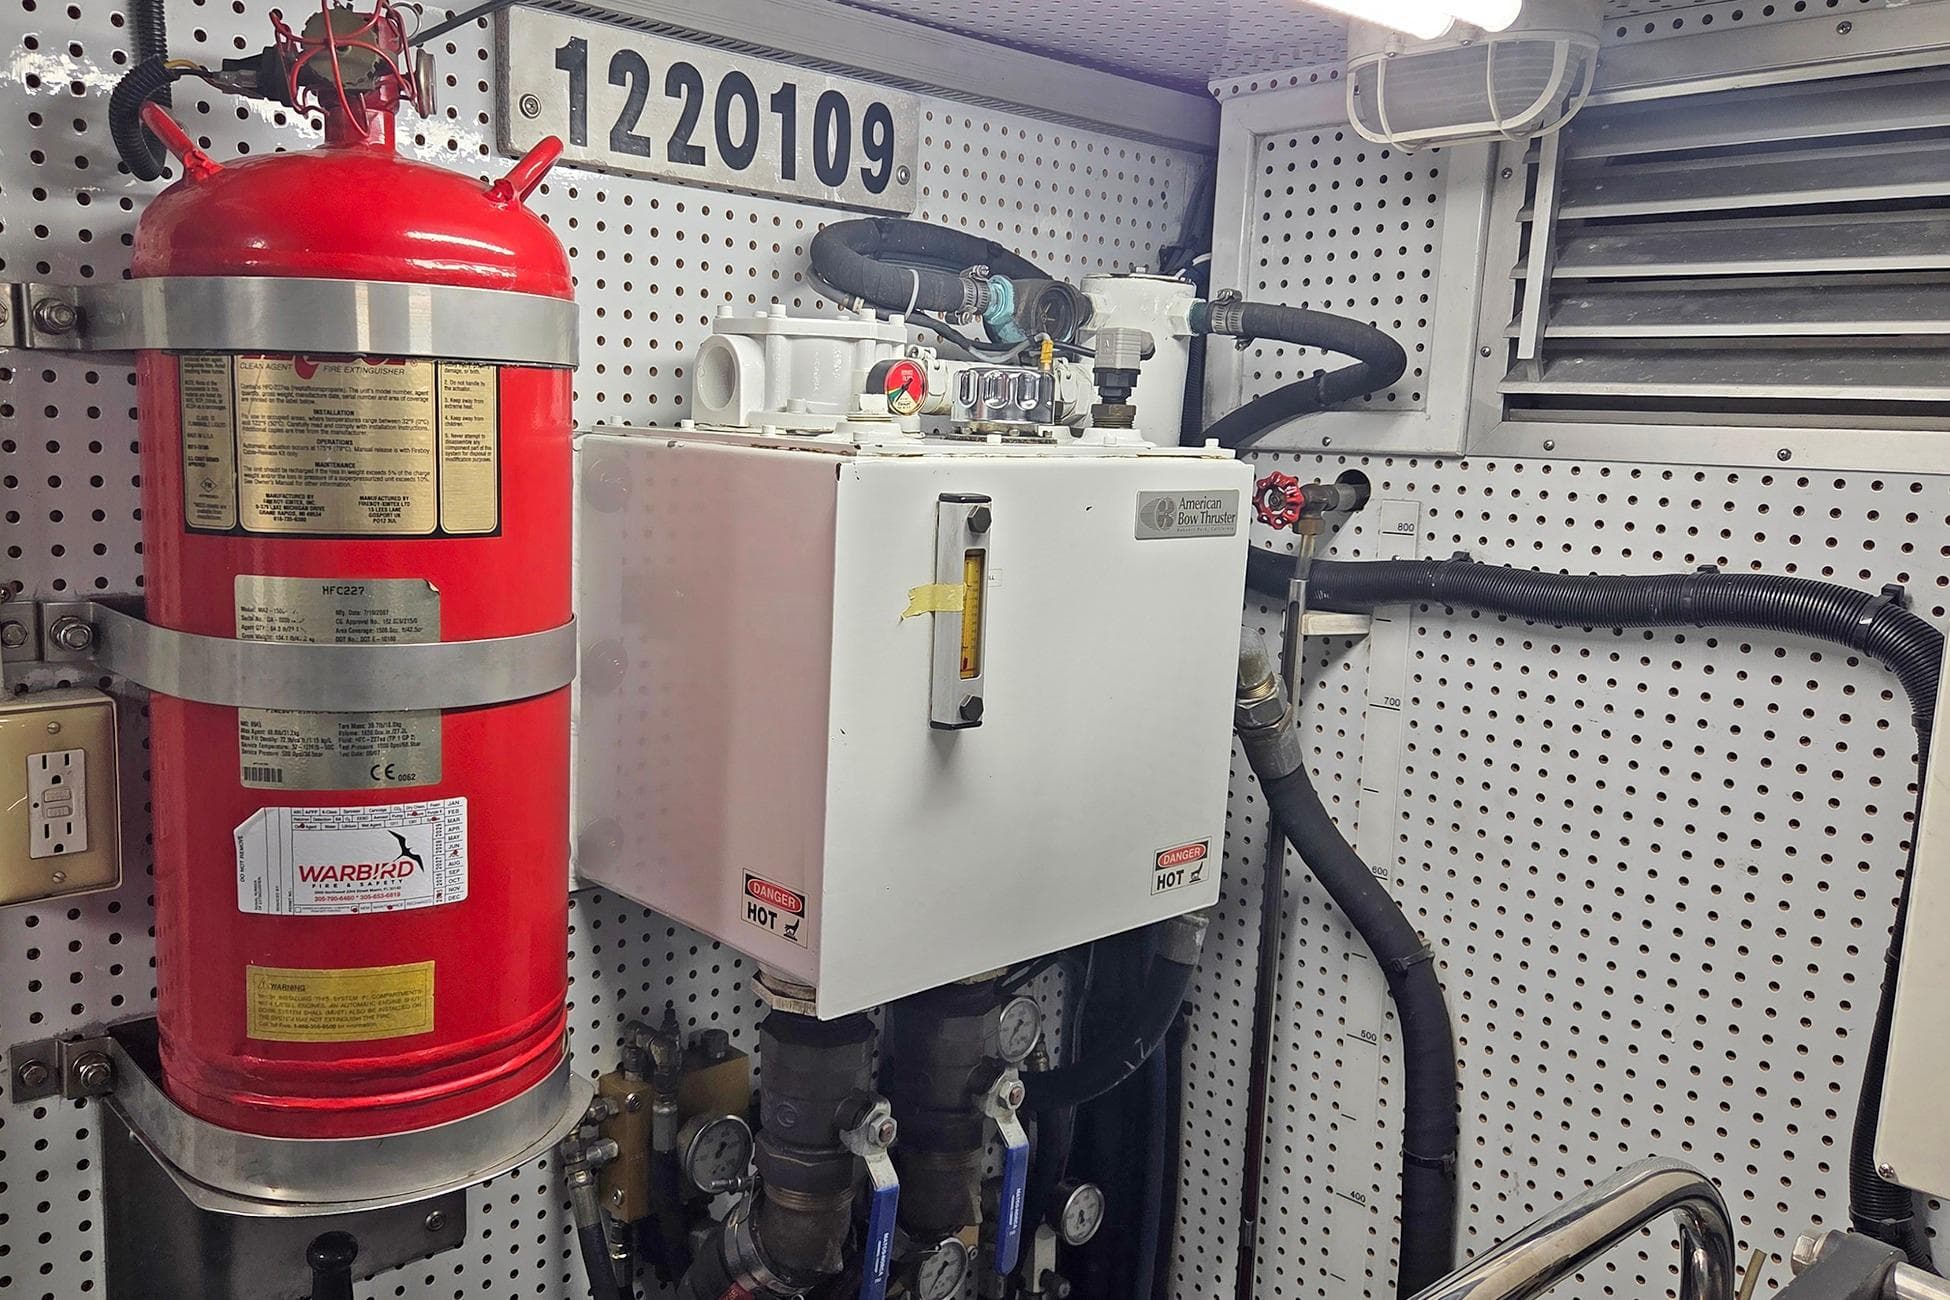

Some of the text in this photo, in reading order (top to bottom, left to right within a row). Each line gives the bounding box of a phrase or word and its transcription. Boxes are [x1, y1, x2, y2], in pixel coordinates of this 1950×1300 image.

[555, 36, 894, 194] 1220109
[240, 362, 264, 370] CLEAN
[344, 366, 406, 376] EXTINGUISHER
[1178, 496, 1221, 510] American
[1178, 511, 1236, 525] Bow Thruster
[1397, 523, 1415, 532] 800
[322, 586, 365, 595] HFC227
[348, 627, 374, 635] Coverage:
[1384, 696, 1400, 707] 700
[370, 763, 395, 780] CE
[1164, 847, 1200, 864] DANGER
[299, 861, 414, 882] WARBIRD
[1372, 866, 1388, 876] 600
[240, 873, 245, 882] DO
[1157, 869, 1184, 890] HOT
[753, 882, 795, 909] DANGER
[748, 902, 777, 929] HOT
[270, 984, 306, 992] WARNING
[371, 990, 422, 999] COMPARTMENTS
[1361, 1030, 1377, 1041] 500
[1350, 1191, 1366, 1202] 400
